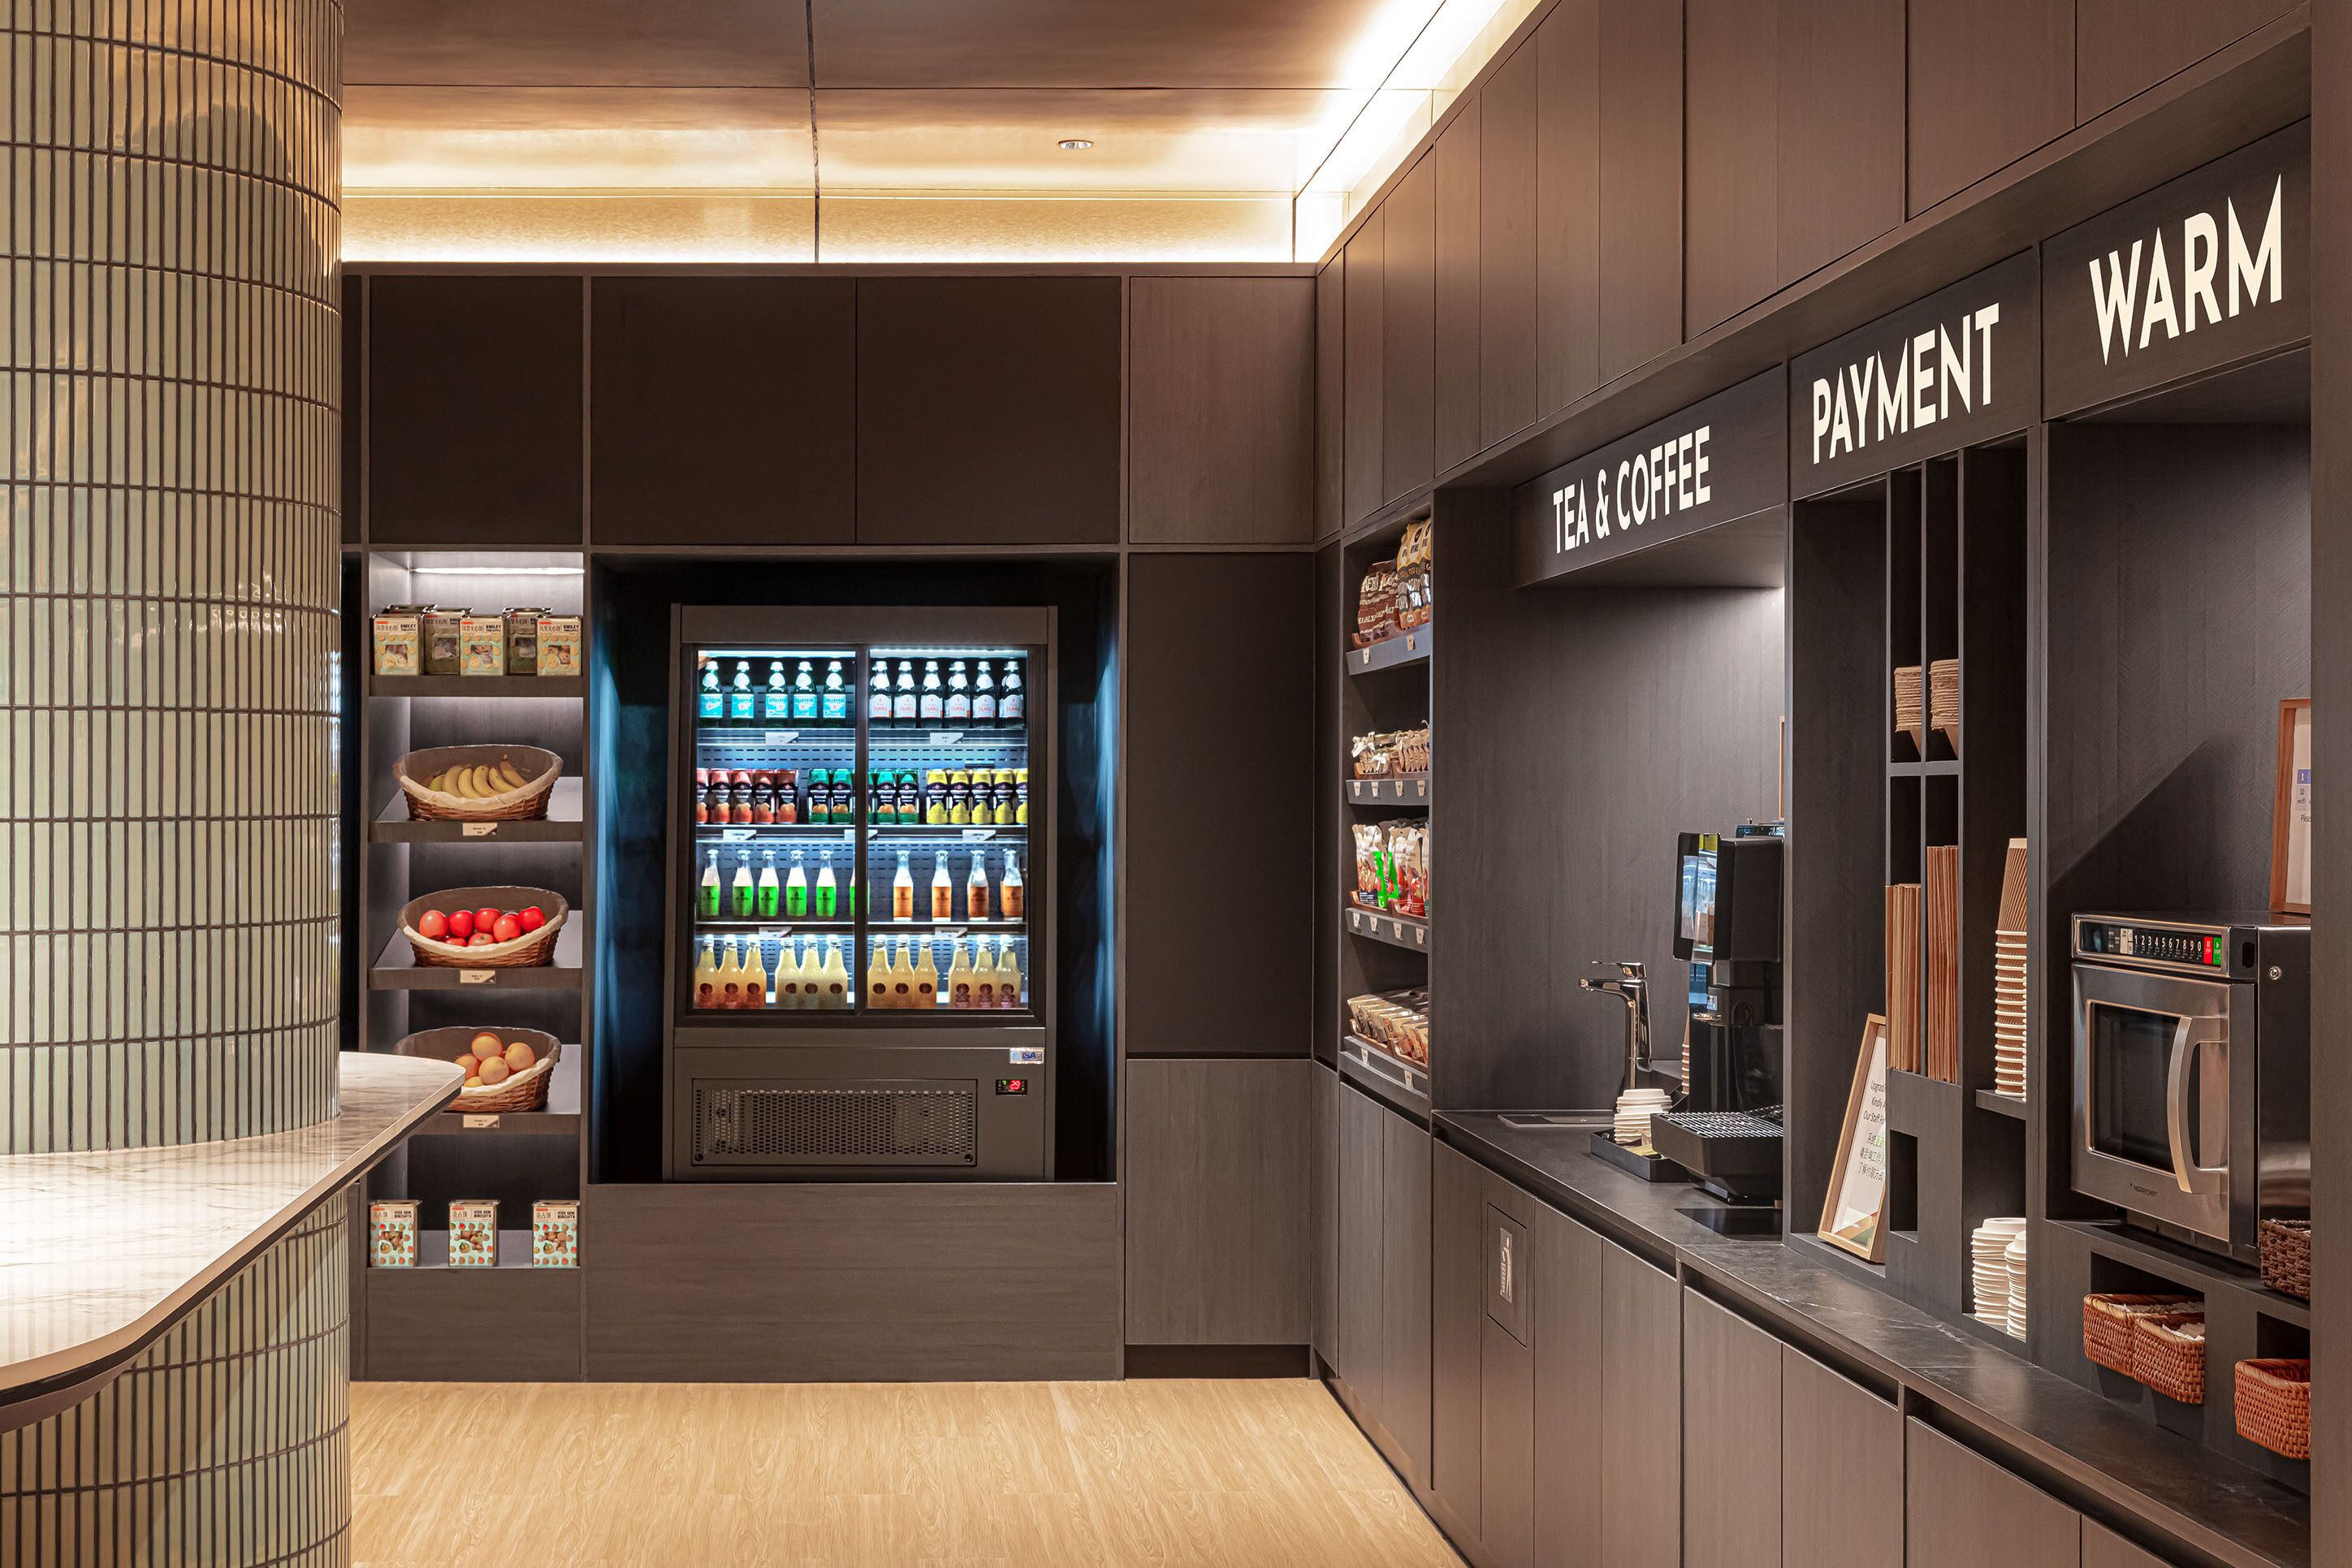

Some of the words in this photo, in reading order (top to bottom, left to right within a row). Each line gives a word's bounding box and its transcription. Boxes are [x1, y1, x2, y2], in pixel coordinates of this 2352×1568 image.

[2089, 174, 2282, 365] WARM
[1814, 303, 2000, 464] PAYMENT
[1553, 478, 1589, 554] TEA
[1595, 469, 1611, 539] &
[1617, 425, 1710, 530] COFFEE
[2135, 935, 2138, 945] 1
[2141, 935, 2145, 945] 2
[2148, 936, 2152, 946] 3
[2155, 937, 2159, 947] 4
[2162, 937, 2165, 947] 5
[2168, 938, 2173, 948] 6
[2175, 939, 2180, 949] 7
[2183, 940, 2187, 950] 8
[2190, 940, 2194, 951] 9
[2197, 941, 2201, 951] 0
